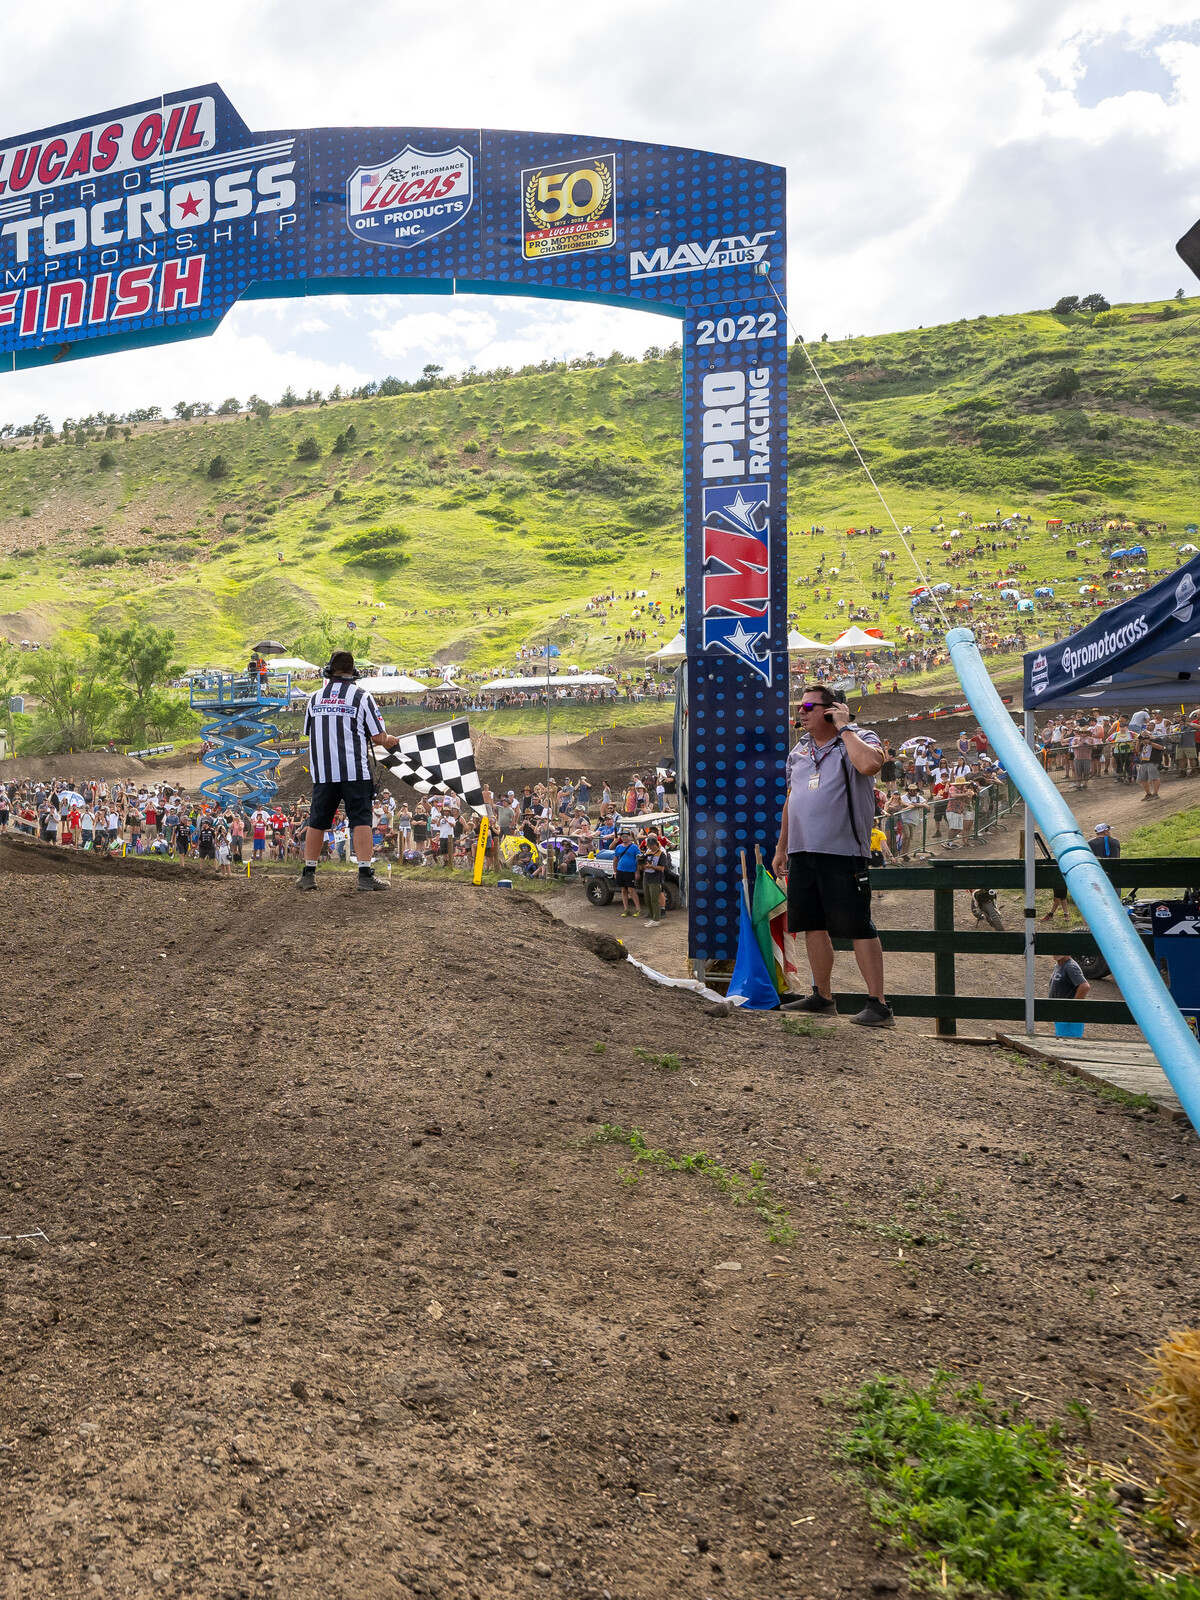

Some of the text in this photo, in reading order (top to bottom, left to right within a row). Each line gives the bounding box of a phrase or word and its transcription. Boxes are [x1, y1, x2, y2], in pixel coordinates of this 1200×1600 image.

[132, 102, 205, 163] OIL
[411, 163, 464, 178] PERFORMANCE
[40, 172, 141, 209] PRO
[361, 172, 462, 211] LUCAS
[536, 169, 604, 222] 50
[355, 201, 463, 230] OIL PRODUCTS
[395, 225, 425, 238] INC.
[549, 224, 589, 237] LUCAS OIL
[529, 230, 609, 249] PRO MOTOCROSS
[540, 240, 598, 253] CHAMPIONSHIP
[719, 249, 755, 265] PLUS
[696, 313, 777, 345] 2022
[703, 371, 745, 478] PRO
[750, 368, 770, 474] RACING
[1062, 614, 1149, 678] @promotocross
